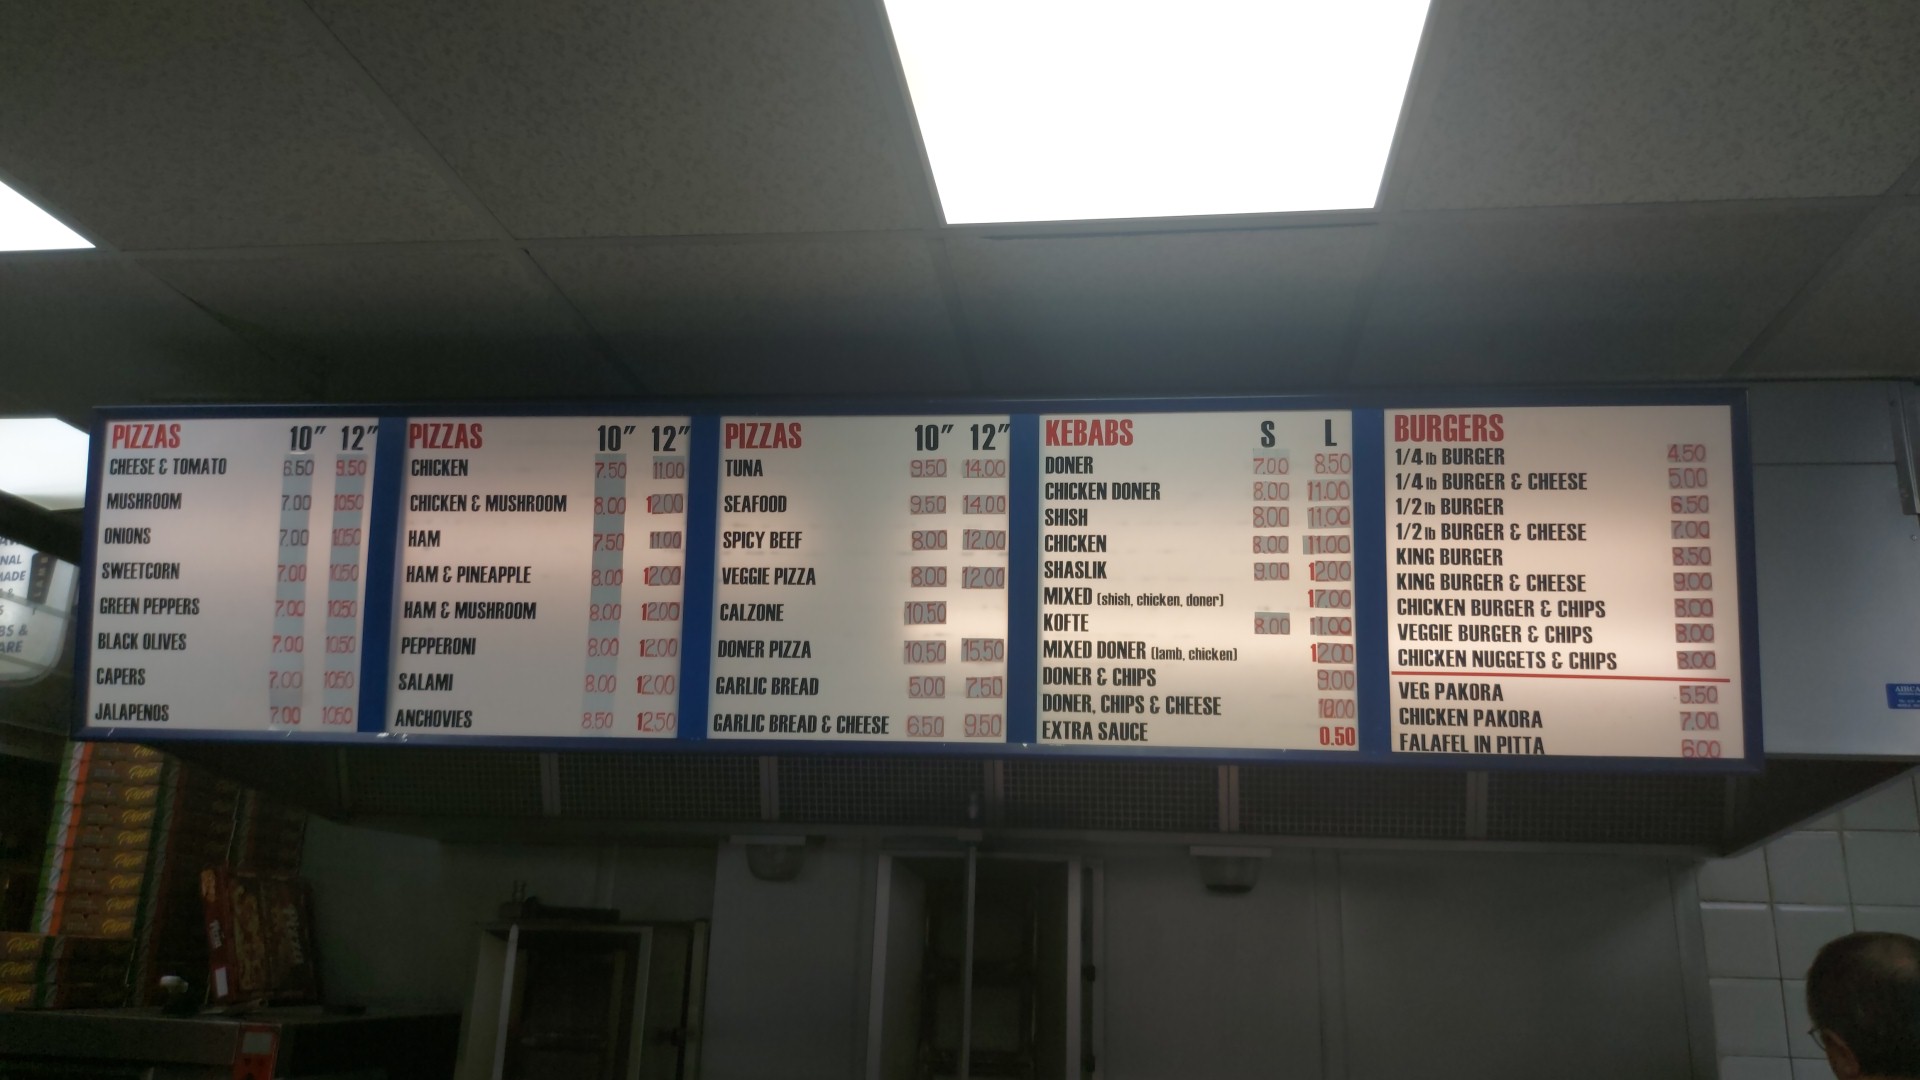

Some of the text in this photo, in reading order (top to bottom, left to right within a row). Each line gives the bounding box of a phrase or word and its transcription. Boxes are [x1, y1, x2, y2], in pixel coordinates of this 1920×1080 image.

[112, 424, 181, 449] PIZZAS
[409, 423, 483, 449] PIZZAS
[725, 422, 801, 449] PIZZAS
[1045, 419, 1133, 446] KEBABS
[1261, 421, 1275, 447] S
[1325, 419, 1337, 446] L
[1394, 414, 1504, 442] BURGERS
[1396, 448, 1504, 465] 1/4 lb BURGER
[1668, 445, 1706, 462] 4.50
[110, 458, 226, 474] CHEESE & TOMATO
[336, 460, 366, 476] 9.50
[411, 459, 468, 476] CHICKEN
[595, 462, 626, 478] 7.50
[725, 459, 763, 476] TUNA
[910, 459, 946, 477] 9.50
[963, 459, 1005, 477] 14.00
[1045, 456, 1093, 474] DONER
[1253, 458, 1289, 473] 7.00
[1314, 454, 1350, 473] 8.50
[1308, 481, 1350, 500] 11.00
[1396, 473, 1587, 490] 1/4 lb BURGER & CHEESE
[1045, 482, 1160, 500] CHICKEN DONER
[107, 493, 182, 509] MUSHROOM
[281, 495, 311, 510] 7.00
[410, 495, 567, 512] CHICKEN & MUSHROOM
[594, 497, 626, 514] 8.00
[724, 496, 787, 512] SEAFOOD
[1396, 498, 1503, 515] 1/2 lb BURGER
[1671, 496, 1709, 513] 6.50
[1044, 508, 1088, 526] SHISH
[104, 528, 151, 544] ONIONS
[279, 529, 309, 546] 7.00
[408, 530, 440, 547] HAM
[723, 532, 802, 548] SPICY BEEF
[963, 530, 1005, 550] 12.00
[1396, 523, 1586, 541] 1/2 lb BURGER & CHEESE
[1044, 535, 1107, 553] CHICKEN
[1253, 535, 1288, 553] 8.00
[1396, 548, 1503, 566] KING BURGER
[102, 563, 180, 579] SWEETCORN
[406, 566, 531, 583] HAM & PINEAPPLE
[722, 568, 816, 585] VEGGIE PIZZA
[1044, 561, 1107, 579] SHASLIK
[1396, 573, 1586, 592] KING BURGER & CHEESE
[1673, 573, 1712, 591] 9.00
[100, 598, 199, 615] GREEN PEPPERS
[1044, 587, 1092, 605] MIXED
[1137, 593, 1182, 608] chicken,
[1308, 590, 1350, 608] 17.00
[404, 602, 536, 619] HAM & MUSHROOM
[720, 604, 784, 621] CALZONE
[905, 602, 946, 624] 10.50
[1397, 598, 1605, 618] CHICKEN BURGER & CHIPS
[1043, 614, 1089, 632] KOFTE
[98, 633, 186, 650] BLACK OLIVES
[1398, 623, 1592, 643] VEGGIE BURGER & CHIPS
[401, 637, 476, 654] PEPPERONI
[718, 640, 811, 658] DONER PIZZA
[962, 639, 1003, 661] 15.50
[1043, 640, 1092, 659] MIXED
[1097, 641, 1146, 660] DONER
[1398, 649, 1617, 670] CHICKEN NUGGETS & CHIPS
[96, 668, 145, 685] CAPERS
[398, 673, 453, 691] SALAMI
[1043, 667, 1156, 687] DONER & CHIPS
[1318, 670, 1354, 690] 9.00
[716, 677, 818, 695] GARLIC BREAD
[909, 677, 945, 697] 5.00
[966, 677, 1002, 697] 7.50
[1399, 682, 1503, 701] VEG PAKORA
[1680, 686, 1718, 704] 5.50
[95, 703, 169, 721] JALAPENOS
[1043, 694, 1221, 715] DONER, CHIPS & CHEESE
[395, 709, 472, 728] ANCHOVIES
[713, 714, 889, 734] GARLIC BREAD & CHEESE
[1399, 708, 1542, 728] CHICKEN PAKORA
[1042, 721, 1148, 741] EXTRA SAUCE
[1320, 727, 1355, 745] 0.50
[1400, 733, 1544, 755] FALAFEL IN PITTA
